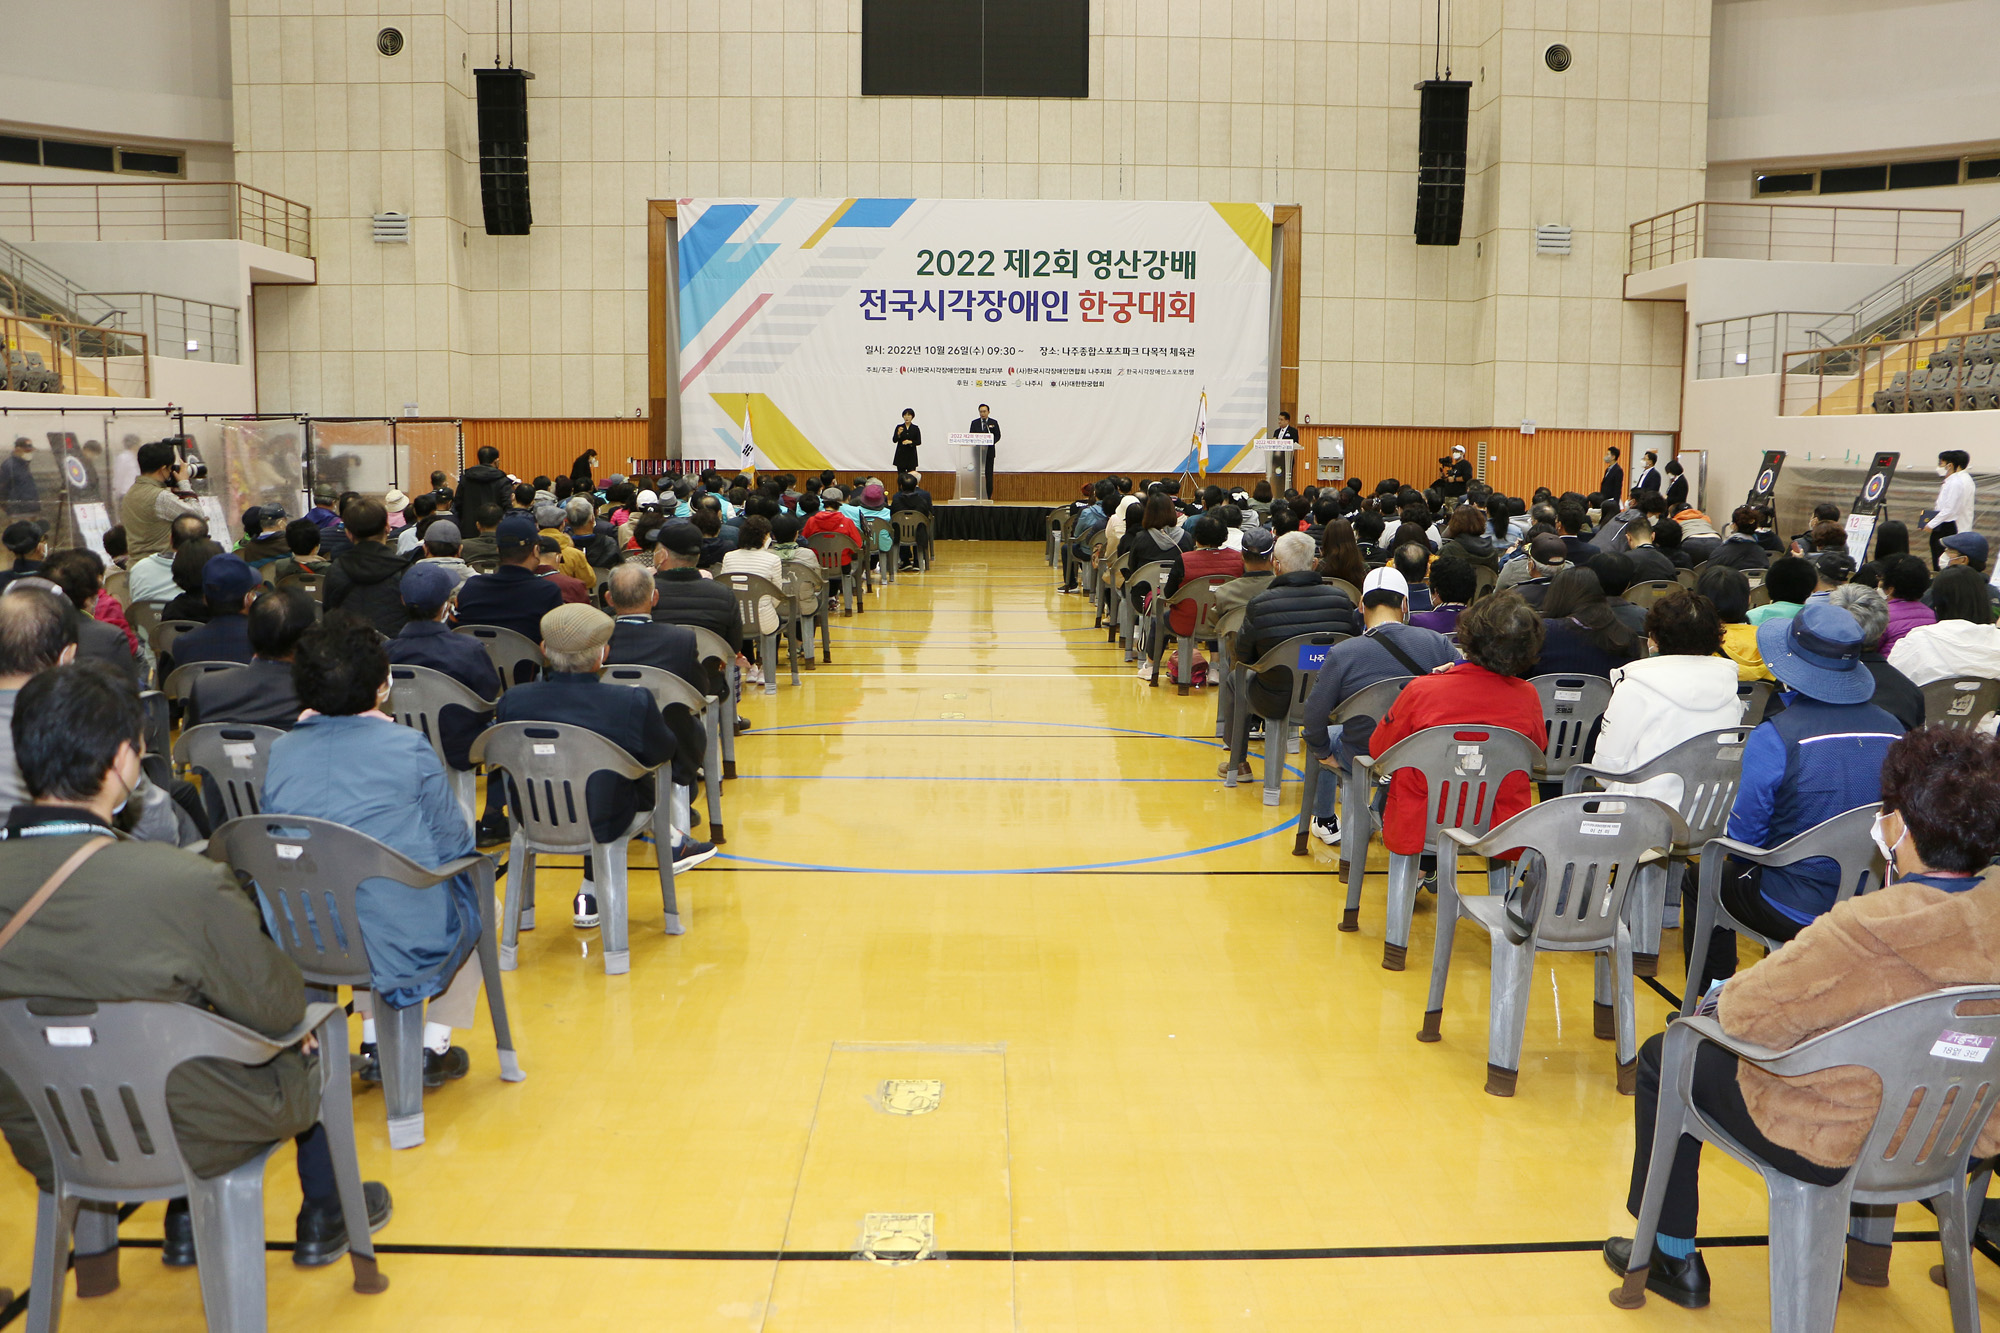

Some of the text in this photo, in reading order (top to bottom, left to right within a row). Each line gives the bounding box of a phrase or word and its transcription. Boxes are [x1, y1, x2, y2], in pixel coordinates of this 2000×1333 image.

[916, 248, 1197, 281] 2022 제2회 영산강배
[859, 288, 1196, 324] 전국시각장애인 한궁대회
[864, 345, 885, 355] 일시:
[887, 345, 922, 356] 2022년
[924, 345, 945, 356] 10월
[947, 345, 985, 356] 26일(수)
[986, 346, 1016, 356] 09:30
[1039, 346, 1196, 358] 장소: 나주종합스포츠파크 다목적 체육관
[1024, 380, 1043, 388] 나주시
[1850, 517, 1860, 528] 12
[1309, 654, 1326, 663] 나주
